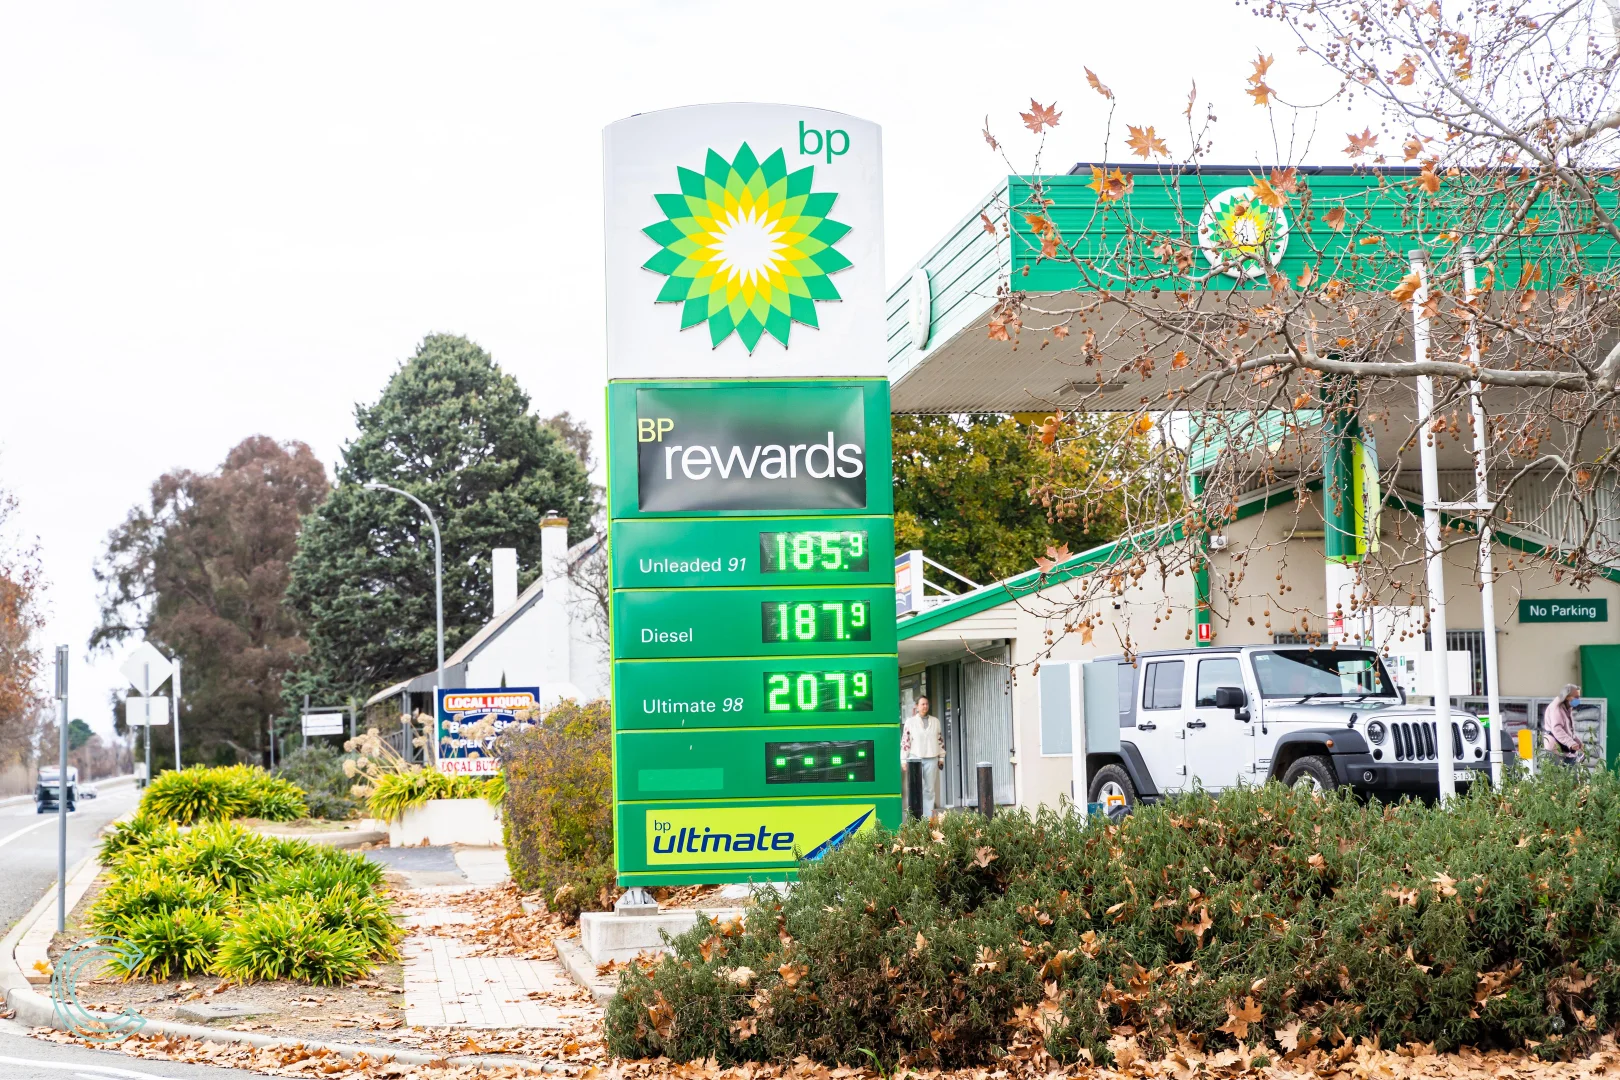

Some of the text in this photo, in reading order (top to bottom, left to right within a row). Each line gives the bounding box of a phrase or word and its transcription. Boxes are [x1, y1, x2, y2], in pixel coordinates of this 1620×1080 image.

[798, 120, 850, 164] bp
[637, 417, 675, 443] BP
[664, 431, 864, 480] rewards
[639, 557, 747, 574] Unleaded 91
[1529, 604, 1597, 619] No Parking
[641, 627, 694, 644] Diesel
[448, 696, 531, 709] LOCAL LIQUOR
[643, 697, 744, 714] Ultimate 98
[441, 760, 473, 773] LOCAL
[654, 819, 671, 834] bp
[653, 825, 795, 854] ultimate
